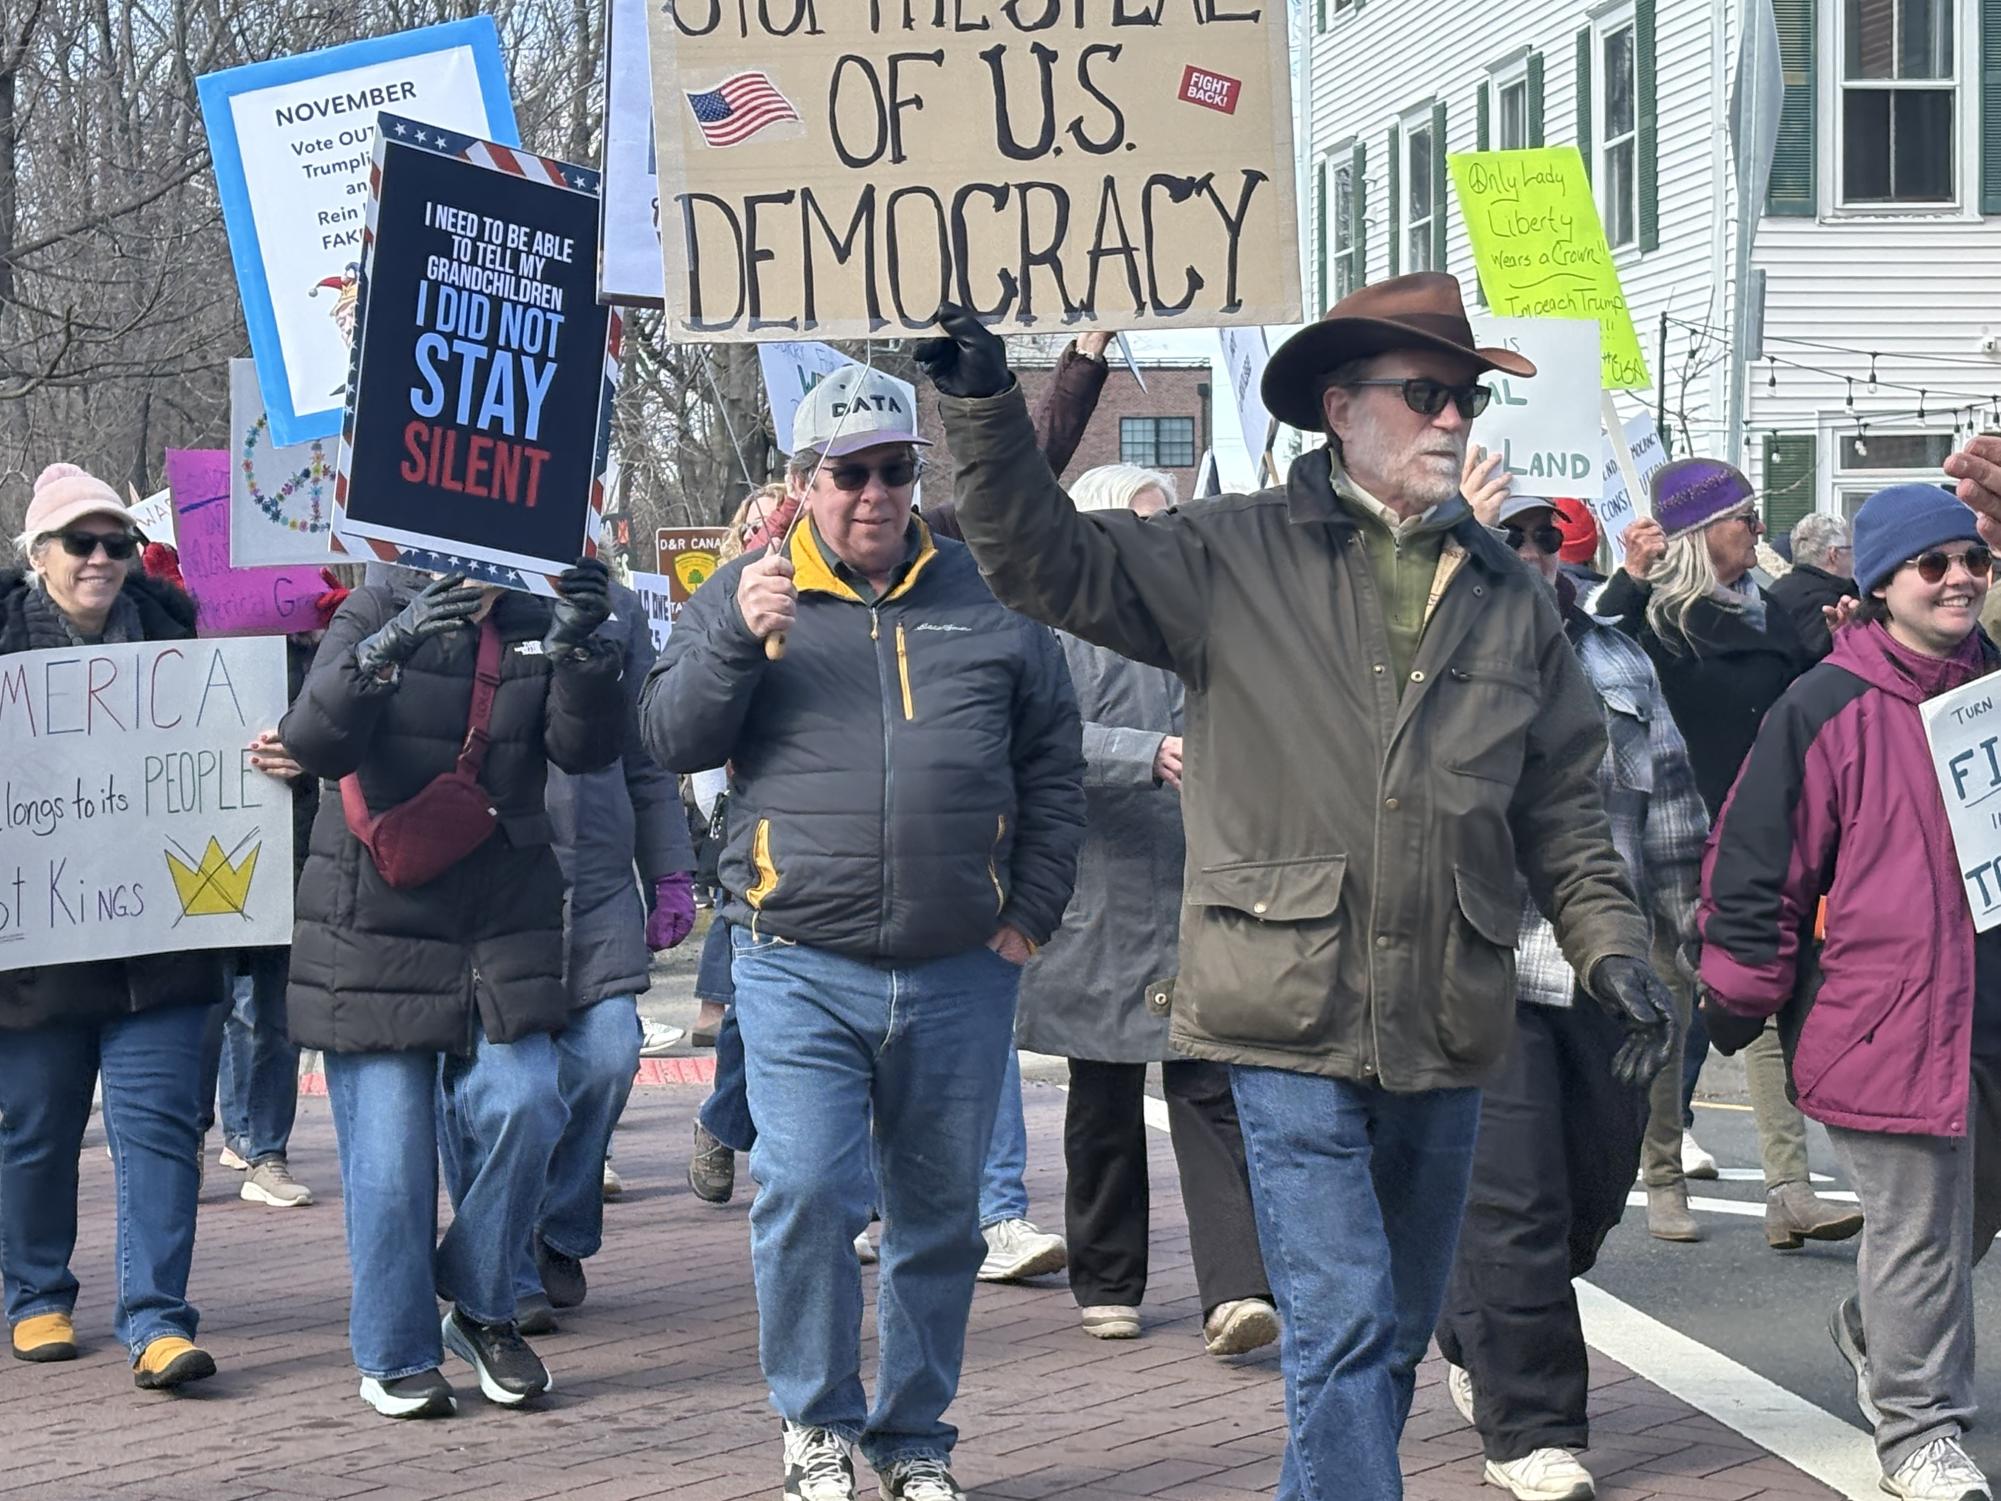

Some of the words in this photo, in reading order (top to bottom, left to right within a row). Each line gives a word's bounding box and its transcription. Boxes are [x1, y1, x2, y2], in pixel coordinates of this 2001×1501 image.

[1187, 86, 1228, 107] BACK!
[1190, 72, 1231, 95] FIGHT
[275, 81, 417, 127] NOVEMBER
[828, 49, 945, 168] OF
[979, 41, 1137, 161] U.S.
[291, 140, 334, 156] Vote
[302, 151, 371, 179] Trumpli
[1522, 161, 1566, 197] Lady
[317, 207, 358, 226] Rein
[425, 201, 432, 226] I
[435, 204, 478, 238] NEED
[483, 217, 504, 245] TO
[507, 224, 530, 251] BE
[532, 231, 574, 263] ABLE
[1488, 206, 1573, 243] Liberty
[322, 228, 363, 250] FAK
[451, 235, 472, 262] TO
[476, 241, 514, 273] TELL
[519, 253, 546, 281] MY
[675, 169, 1269, 333] DEMOCRACY
[1539, 253, 1550, 264] a
[427, 255, 563, 311] GRANDCHILDREN
[1573, 288, 1624, 315] Trump
[416, 280, 428, 326] I
[436, 285, 490, 341] DID
[498, 301, 565, 358] NOT
[410, 332, 558, 441] STAY
[832, 394, 902, 418] DATA
[401, 420, 552, 508] SILENT
[1503, 438, 1591, 480] LAND
[660, 538, 686, 550] D&R
[690, 537, 722, 550] CANA
[0, 648, 246, 737] MERICA
[1951, 697, 1994, 725] TURN
[1949, 736, 2001, 801] FI
[0, 781, 64, 836] longs
[72, 777, 95, 820] to
[101, 774, 128, 815] its
[145, 748, 263, 817] PEOPLE
